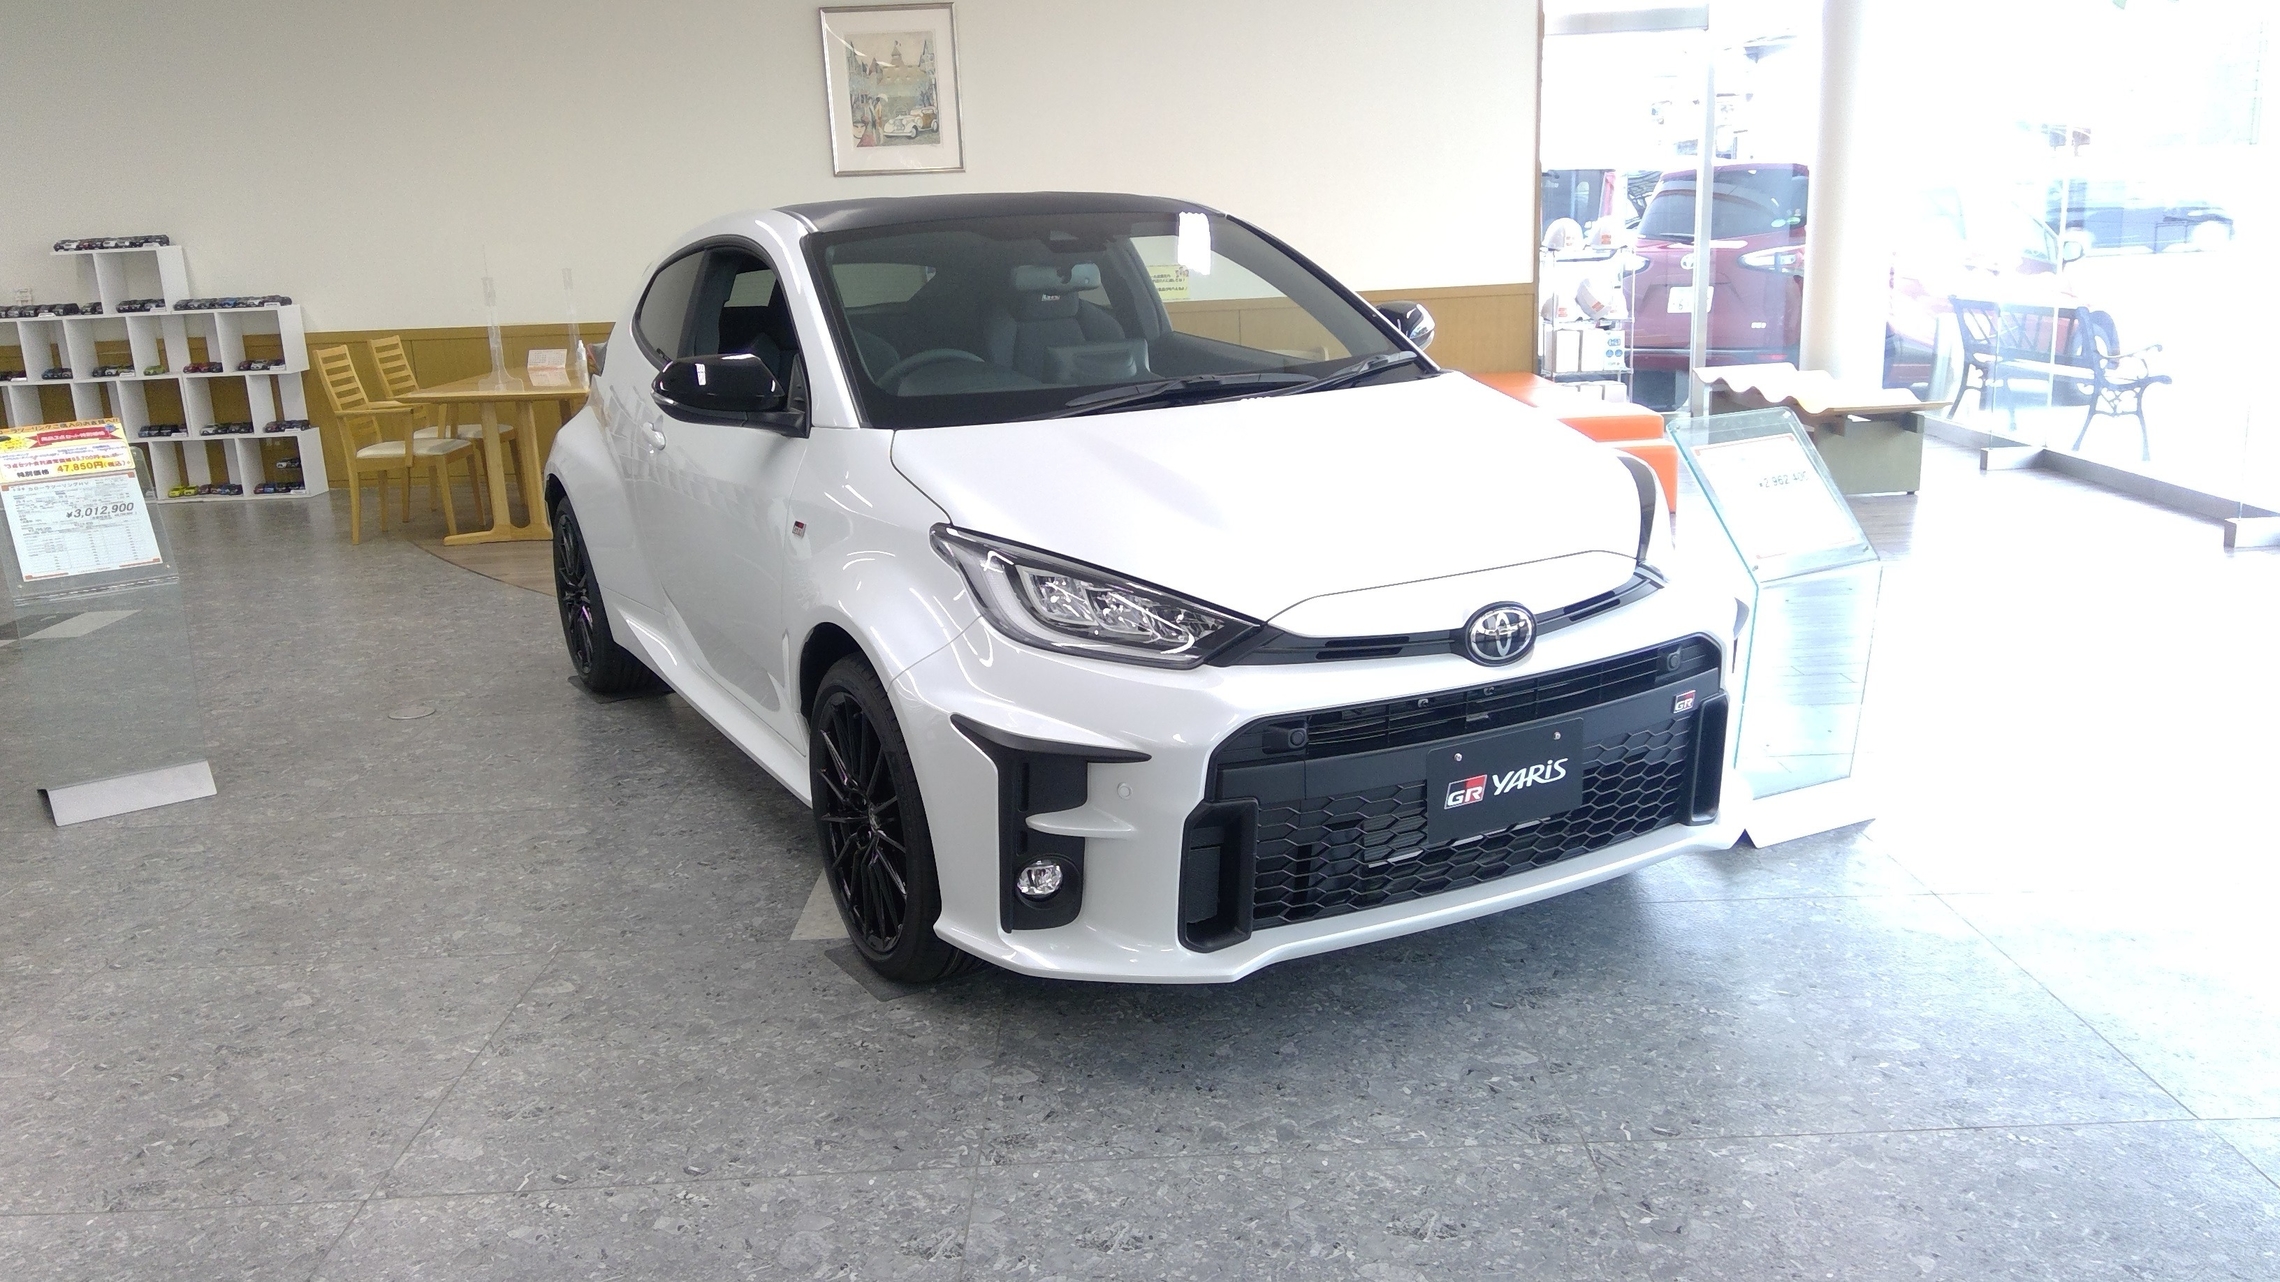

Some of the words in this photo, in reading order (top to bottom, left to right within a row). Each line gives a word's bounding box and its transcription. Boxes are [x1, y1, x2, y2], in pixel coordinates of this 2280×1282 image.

[66, 502, 134, 518] ¥3,012,900
[1674, 697, 1694, 711] GR
[1447, 786, 1483, 806] GR
